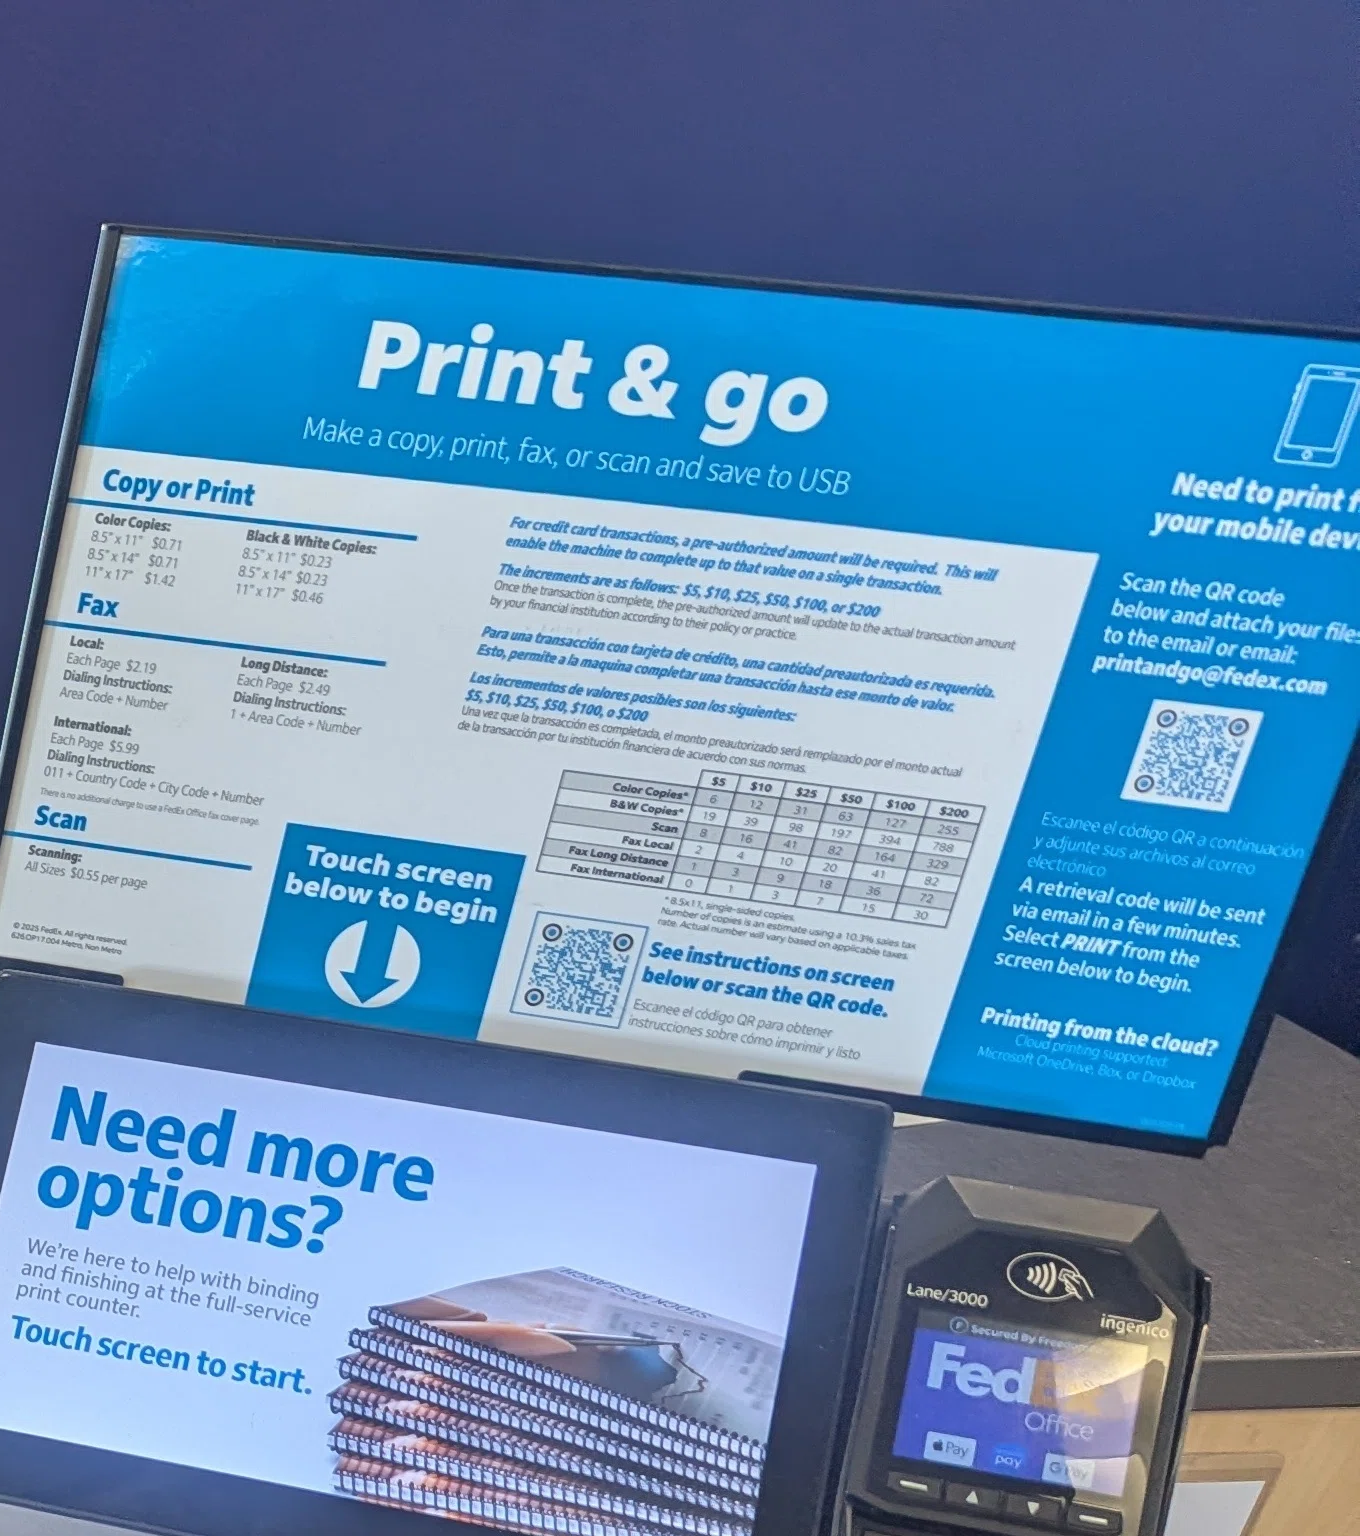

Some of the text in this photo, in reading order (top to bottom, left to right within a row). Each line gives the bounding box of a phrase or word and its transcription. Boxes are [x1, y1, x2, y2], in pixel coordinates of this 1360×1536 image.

[357, 320, 828, 447] Print & go
[302, 416, 851, 495] Make a copy, print, fax, or scan and save to USB
[102, 468, 255, 507] Copy or Print
[1171, 472, 1345, 512] Need to print
[94, 512, 171, 532] Color Copies:
[1148, 512, 1214, 536] your
[1215, 516, 1306, 545] mobile
[245, 529, 377, 555] Black & White Copies:
[77, 592, 119, 618] Fax
[1119, 572, 1285, 607] Scan the QR code
[1110, 597, 1170, 622] below
[1171, 607, 1210, 626] and
[1209, 611, 1274, 633] attach
[1273, 621, 1322, 640] your
[1103, 625, 1298, 664] to the email or email:
[1091, 652, 1328, 695] printandgo@fedex.com
[34, 804, 87, 832] Scan
[27, 844, 83, 865] Scanning:
[306, 844, 492, 891] Touch screen
[23, 860, 148, 889] All Sizes $0.55 per page
[283, 871, 497, 925] below to begin
[648, 941, 896, 992] See instructions on screen
[641, 965, 888, 1018] below or scan the QR code.
[50, 1085, 434, 1202] Need more
[37, 1165, 344, 1254] options?
[27, 1237, 319, 1310] We're here to help with binding
[15, 1282, 140, 1318] print counter.
[20, 1262, 317, 1327] and finishing at the full-service
[906, 1282, 989, 1309] Lane/3000
[1100, 1313, 1170, 1340] ingenico
[11, 1314, 312, 1395] Touch screen to start.
[1024, 1411, 1095, 1442] Office
